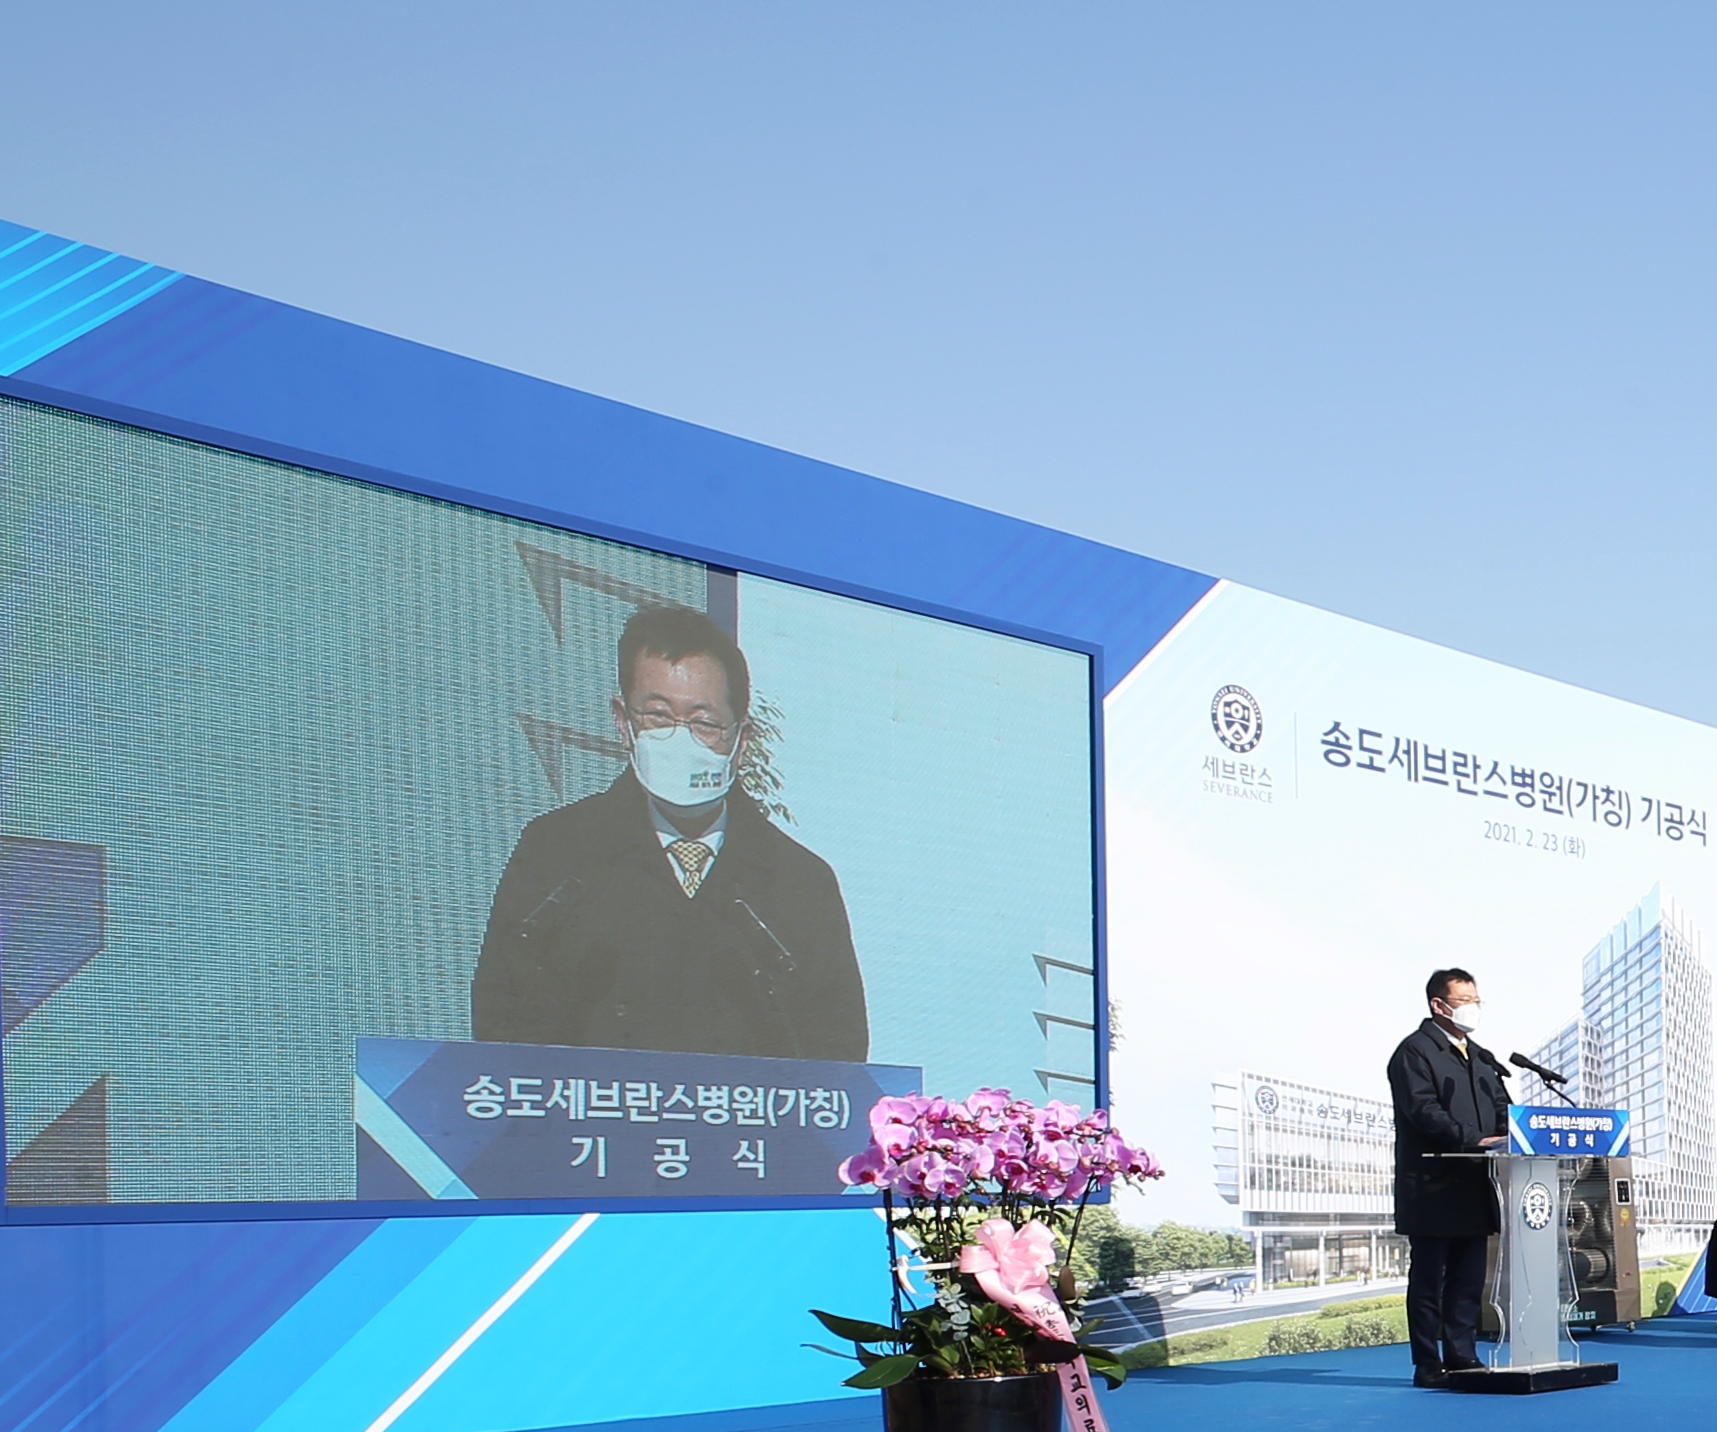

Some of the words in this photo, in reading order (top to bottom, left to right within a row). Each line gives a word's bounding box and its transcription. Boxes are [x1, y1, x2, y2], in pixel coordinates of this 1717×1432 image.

[1202, 754, 1273, 789] 세브란스
[1320, 719, 1632, 831] 송도세브란스병원(가칭)
[1640, 796, 1708, 848] 기공식
[1202, 779, 1273, 804] SEVERANCE
[1484, 820, 1522, 846] 2021.
[1542, 832, 1559, 853] 23
[1562, 836, 1587, 860] (화)
[463, 1074, 851, 1130] 송도세브란스병원(가칭)
[1529, 1114, 1614, 1132] 송도세브란스병원(가칭)
